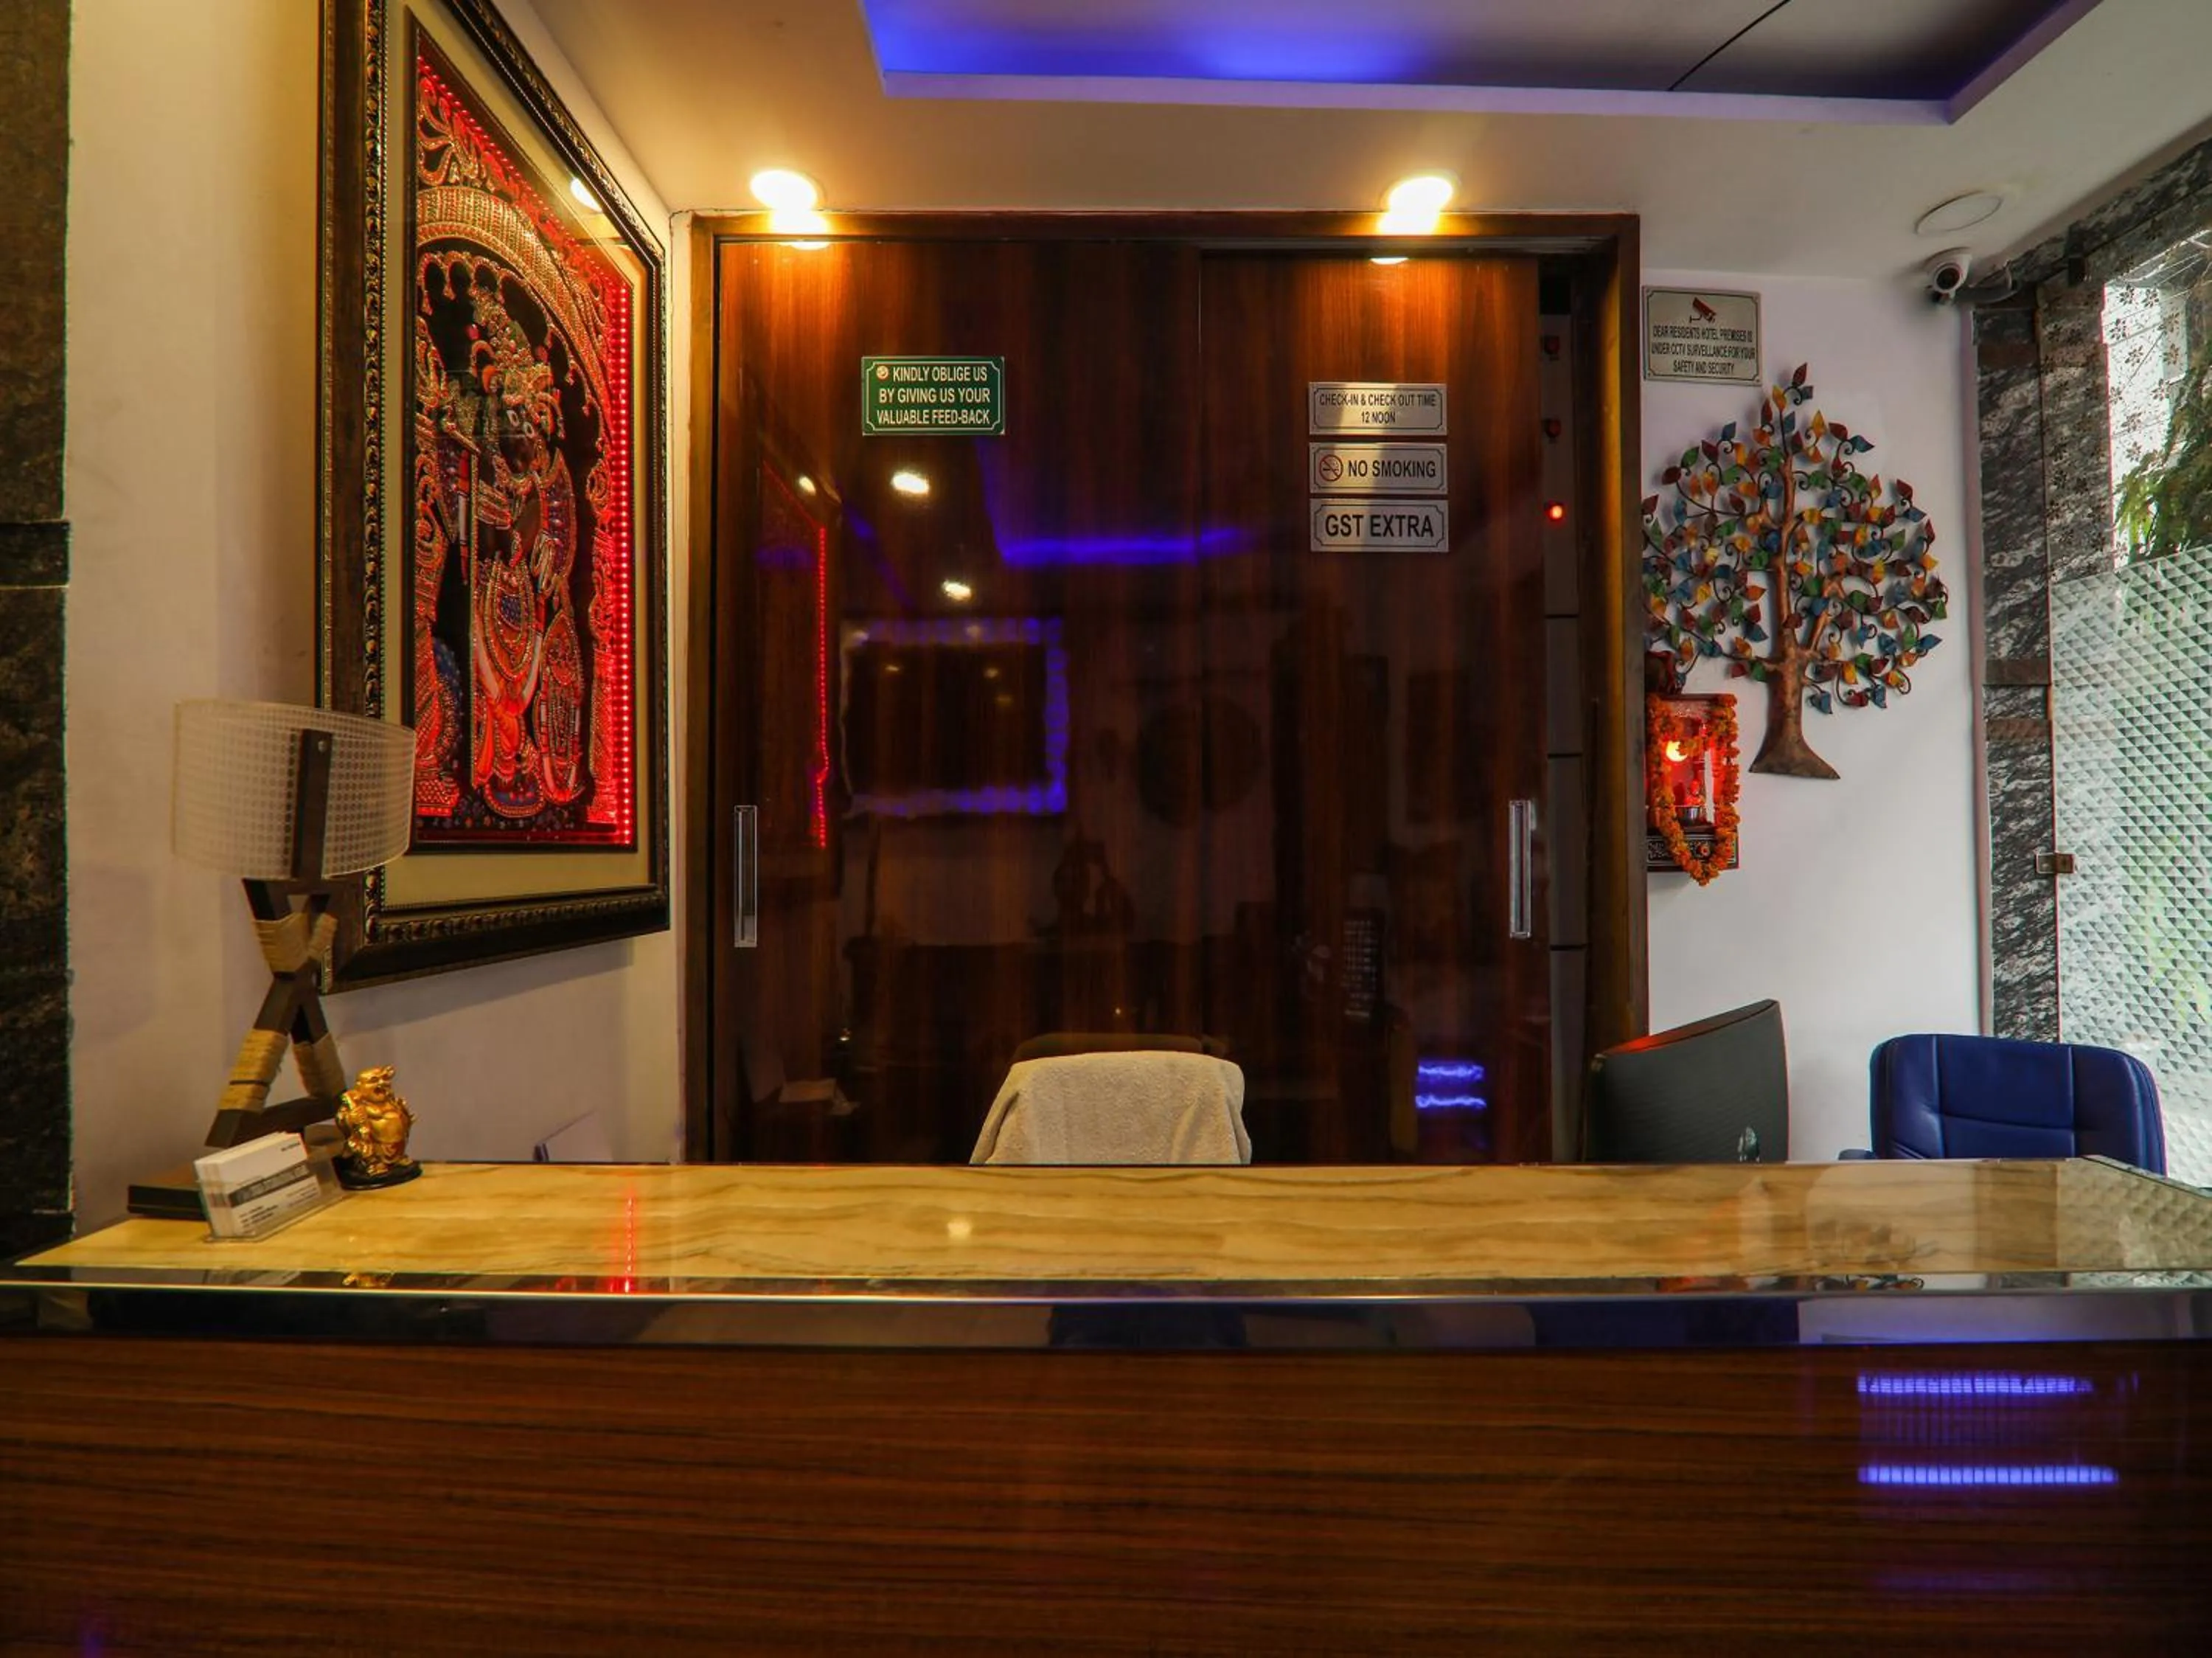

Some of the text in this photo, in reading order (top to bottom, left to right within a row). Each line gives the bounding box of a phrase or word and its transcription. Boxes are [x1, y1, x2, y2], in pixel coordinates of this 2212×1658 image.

[1653, 325, 1669, 338] DEAR
[1669, 326, 1700, 339] RESIDENTS
[1702, 327, 1718, 340] HOTEL
[1719, 328, 1747, 342] PREMISES
[1651, 342, 1756, 360] UNDER CCTV SURVEILLANCE FOR YOUR
[893, 367, 987, 381] KINDLY OBLIGE US
[1673, 359, 1735, 375] SAFETY AND SECURITY
[879, 388, 990, 403] BY GIVING US YOUR
[1319, 393, 1360, 406] CHECK-IN
[1368, 393, 1396, 406] CHECK
[1398, 394, 1415, 406] OUT
[1417, 395, 1436, 406] TIME
[877, 409, 990, 424] VALUABLE FEED-BACK
[1361, 411, 1396, 423] 12 NOON
[1348, 460, 1436, 478] NO SMOKING
[1325, 515, 1434, 537] GST EXTRA
